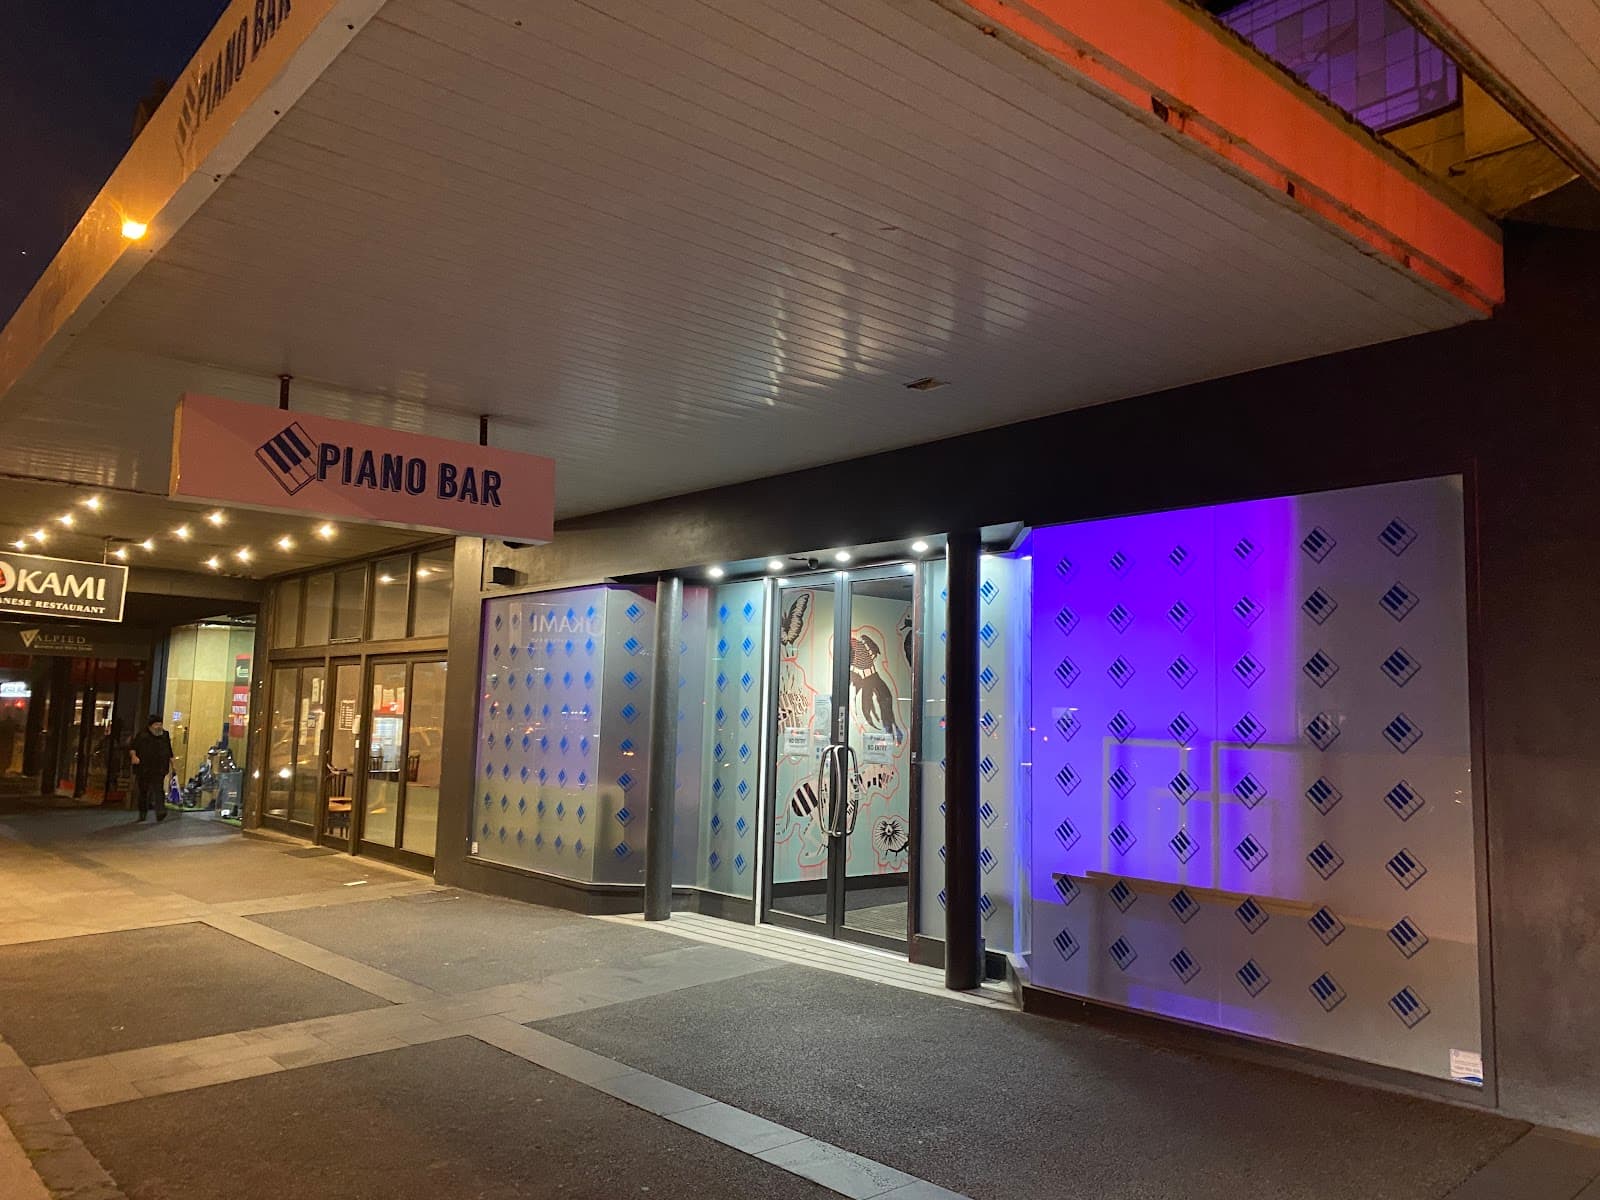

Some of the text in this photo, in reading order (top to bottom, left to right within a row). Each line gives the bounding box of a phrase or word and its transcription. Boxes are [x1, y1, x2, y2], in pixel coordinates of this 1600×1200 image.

[196, 15, 249, 129] PIANO
[316, 442, 502, 508] PIANO BAR
[35, 600, 106, 614] RESTAURANT
